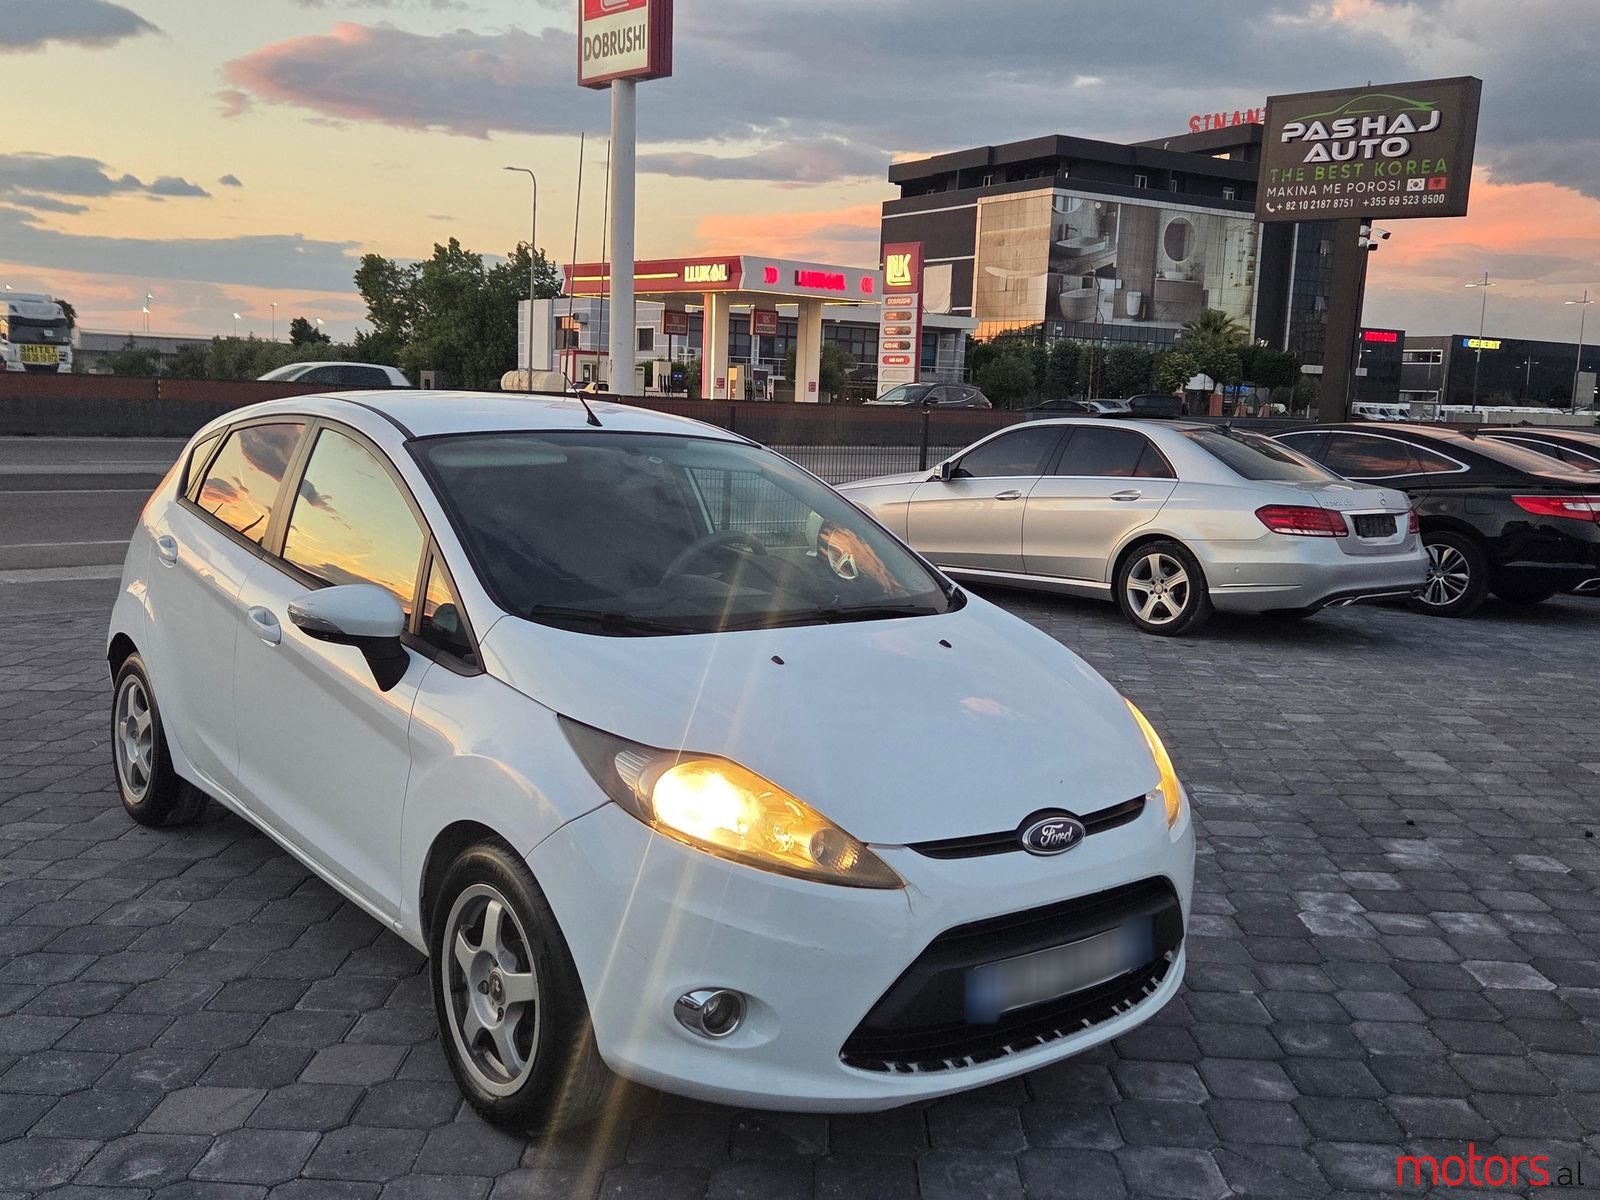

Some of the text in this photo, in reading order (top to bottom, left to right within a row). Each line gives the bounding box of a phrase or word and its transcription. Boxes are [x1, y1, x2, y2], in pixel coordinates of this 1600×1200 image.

[583, 23, 646, 62] DOBRUSHI
[1189, 107, 1266, 133] SINAN
[1280, 110, 1441, 143] PASHAJ
[1303, 136, 1411, 163] AUTO
[1270, 158, 1448, 183] THE BEST KOREA
[1266, 180, 1400, 198] MAKINA ME POROSI
[1285, 201, 1297, 211] 82
[1299, 200, 1309, 210] 10
[1310, 199, 1331, 209] 2187
[1333, 198, 1354, 208] 8751
[1362, 196, 1387, 207] +355
[1388, 195, 1400, 206] 69
[1402, 194, 1420, 205] 523
[1421, 193, 1445, 204] 8500
[1040, 823, 1074, 847] Ford
